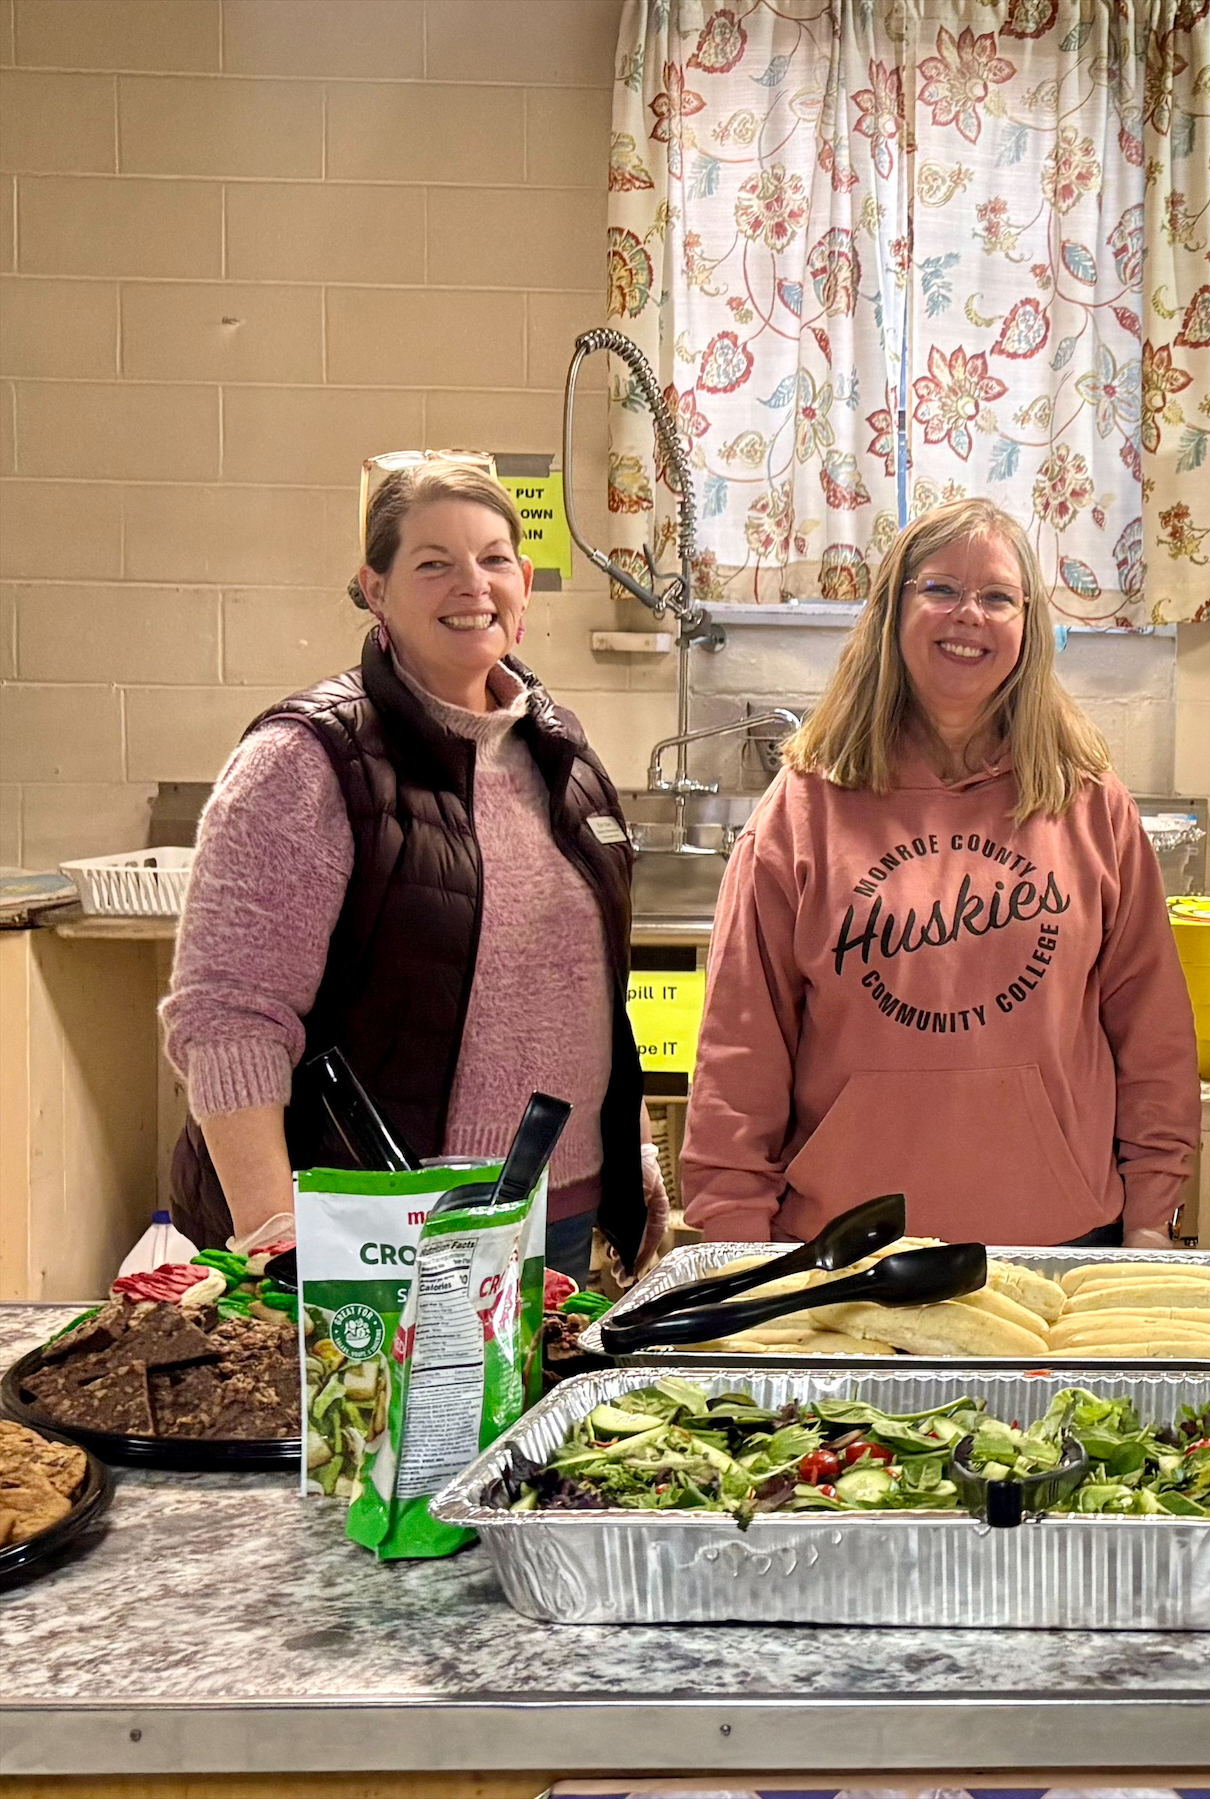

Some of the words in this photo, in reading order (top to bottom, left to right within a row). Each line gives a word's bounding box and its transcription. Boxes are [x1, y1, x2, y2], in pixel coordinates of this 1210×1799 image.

[516, 488, 545, 499] PUT
[520, 509, 553, 519] OWN
[853, 835, 940, 898] MONROE
[950, 834, 1037, 878] COUNTY
[831, 871, 1071, 976] Huskies
[861, 970, 987, 1033] COMMUNITY
[995, 922, 1060, 1013] COLLEGE
[627, 986, 654, 1002] pill
[663, 986, 677, 999] IT
[638, 1044, 658, 1055] pe
[663, 1042, 677, 1055] IT
[359, 1242, 419, 1267] CRO
[420, 1281, 452, 1292] Calories
[357, 1306, 374, 1320] FOR
